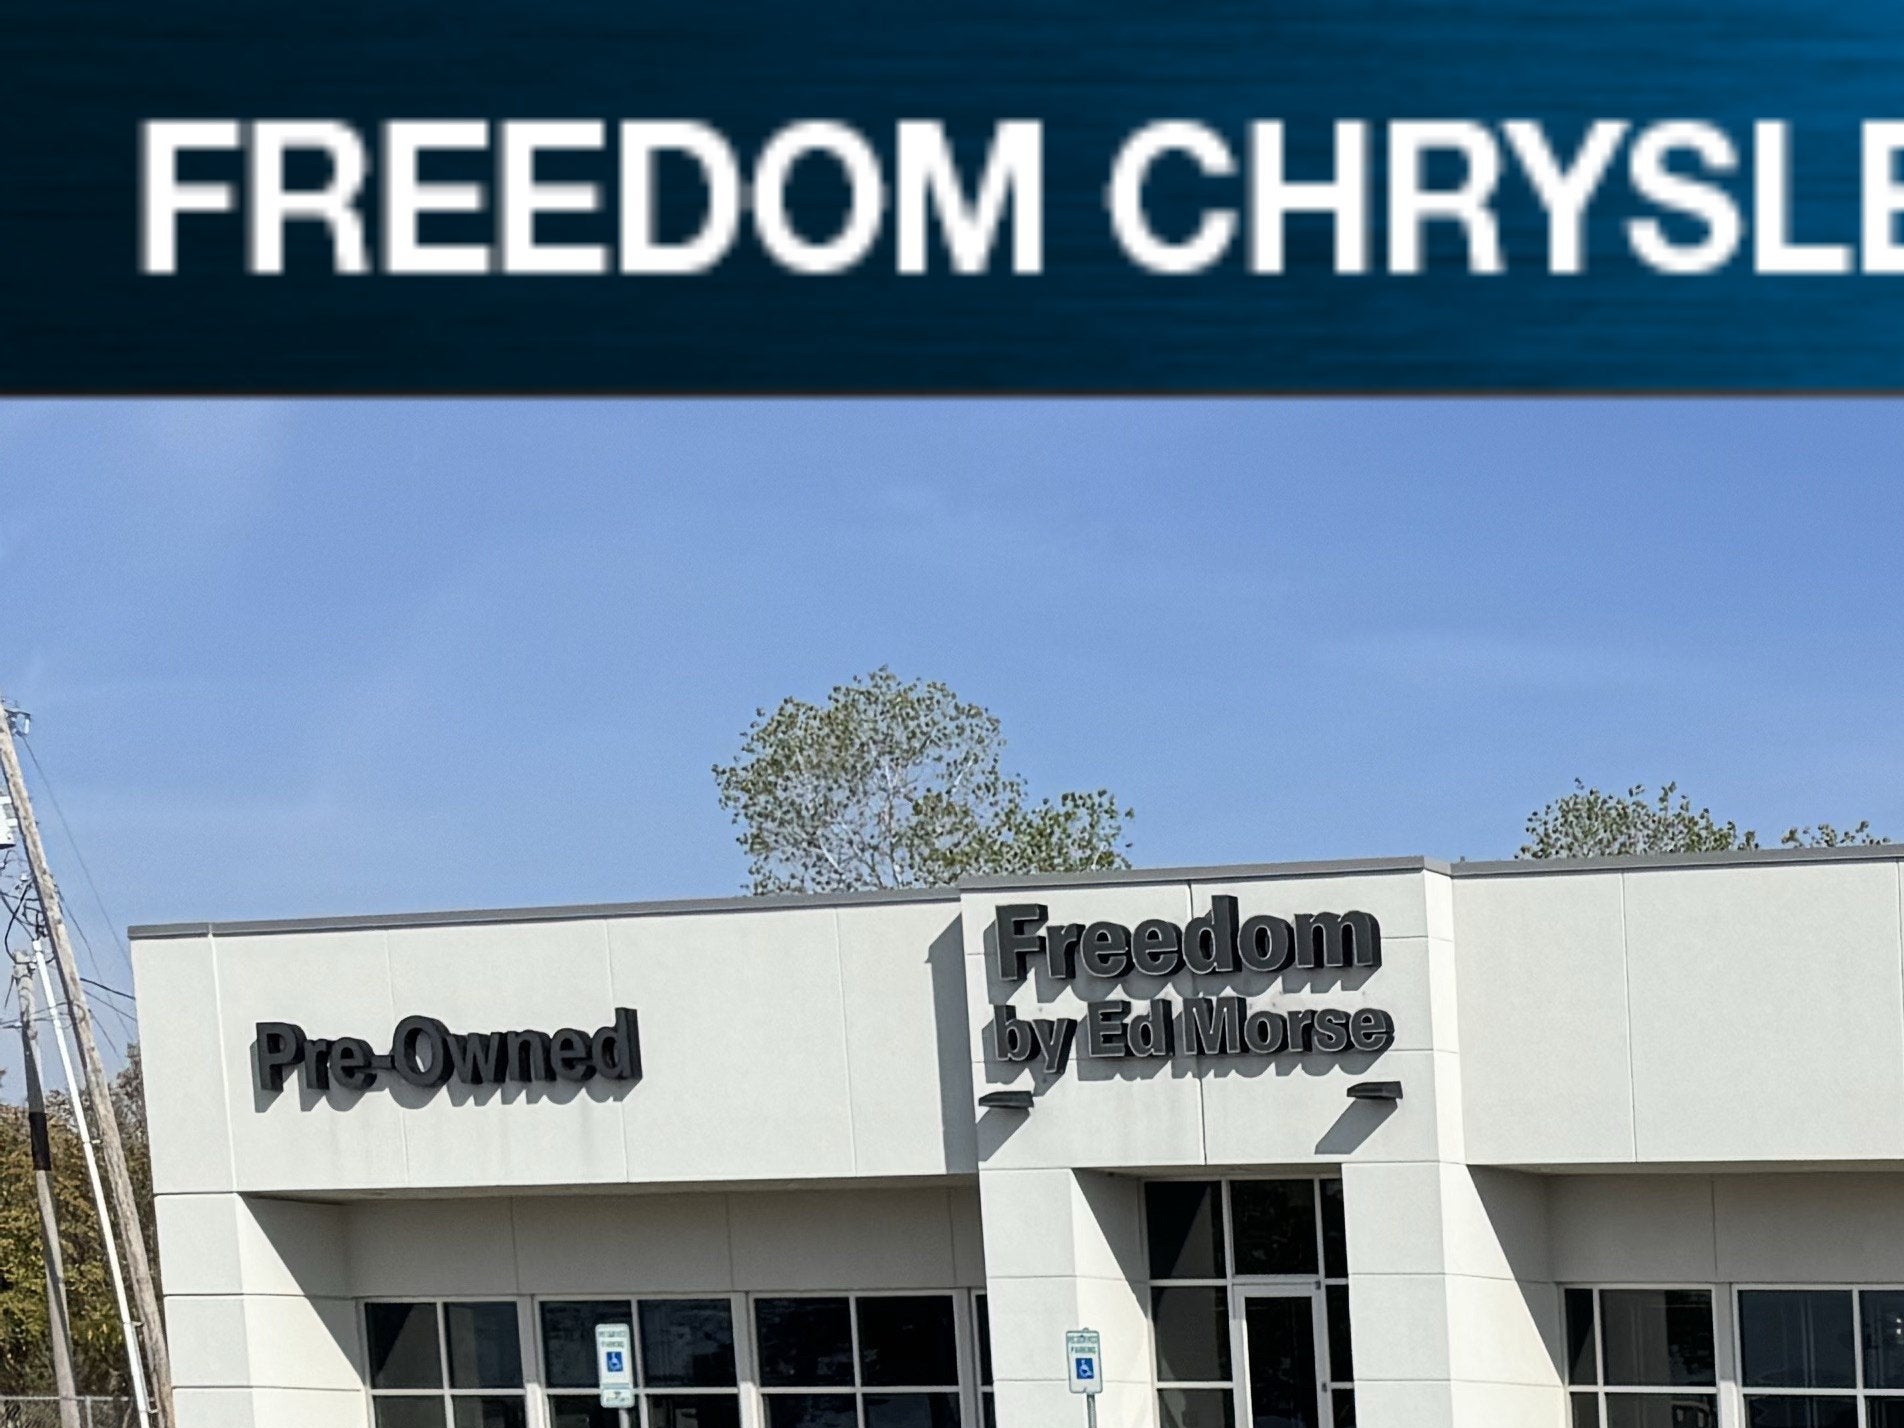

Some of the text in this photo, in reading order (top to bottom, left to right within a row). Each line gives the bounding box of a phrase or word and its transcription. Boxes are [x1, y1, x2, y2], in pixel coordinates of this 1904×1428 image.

[995, 894, 1383, 981] Freedom
[256, 1007, 643, 1092] Pre-Owned
[993, 996, 1396, 1074] by Ed Morse
